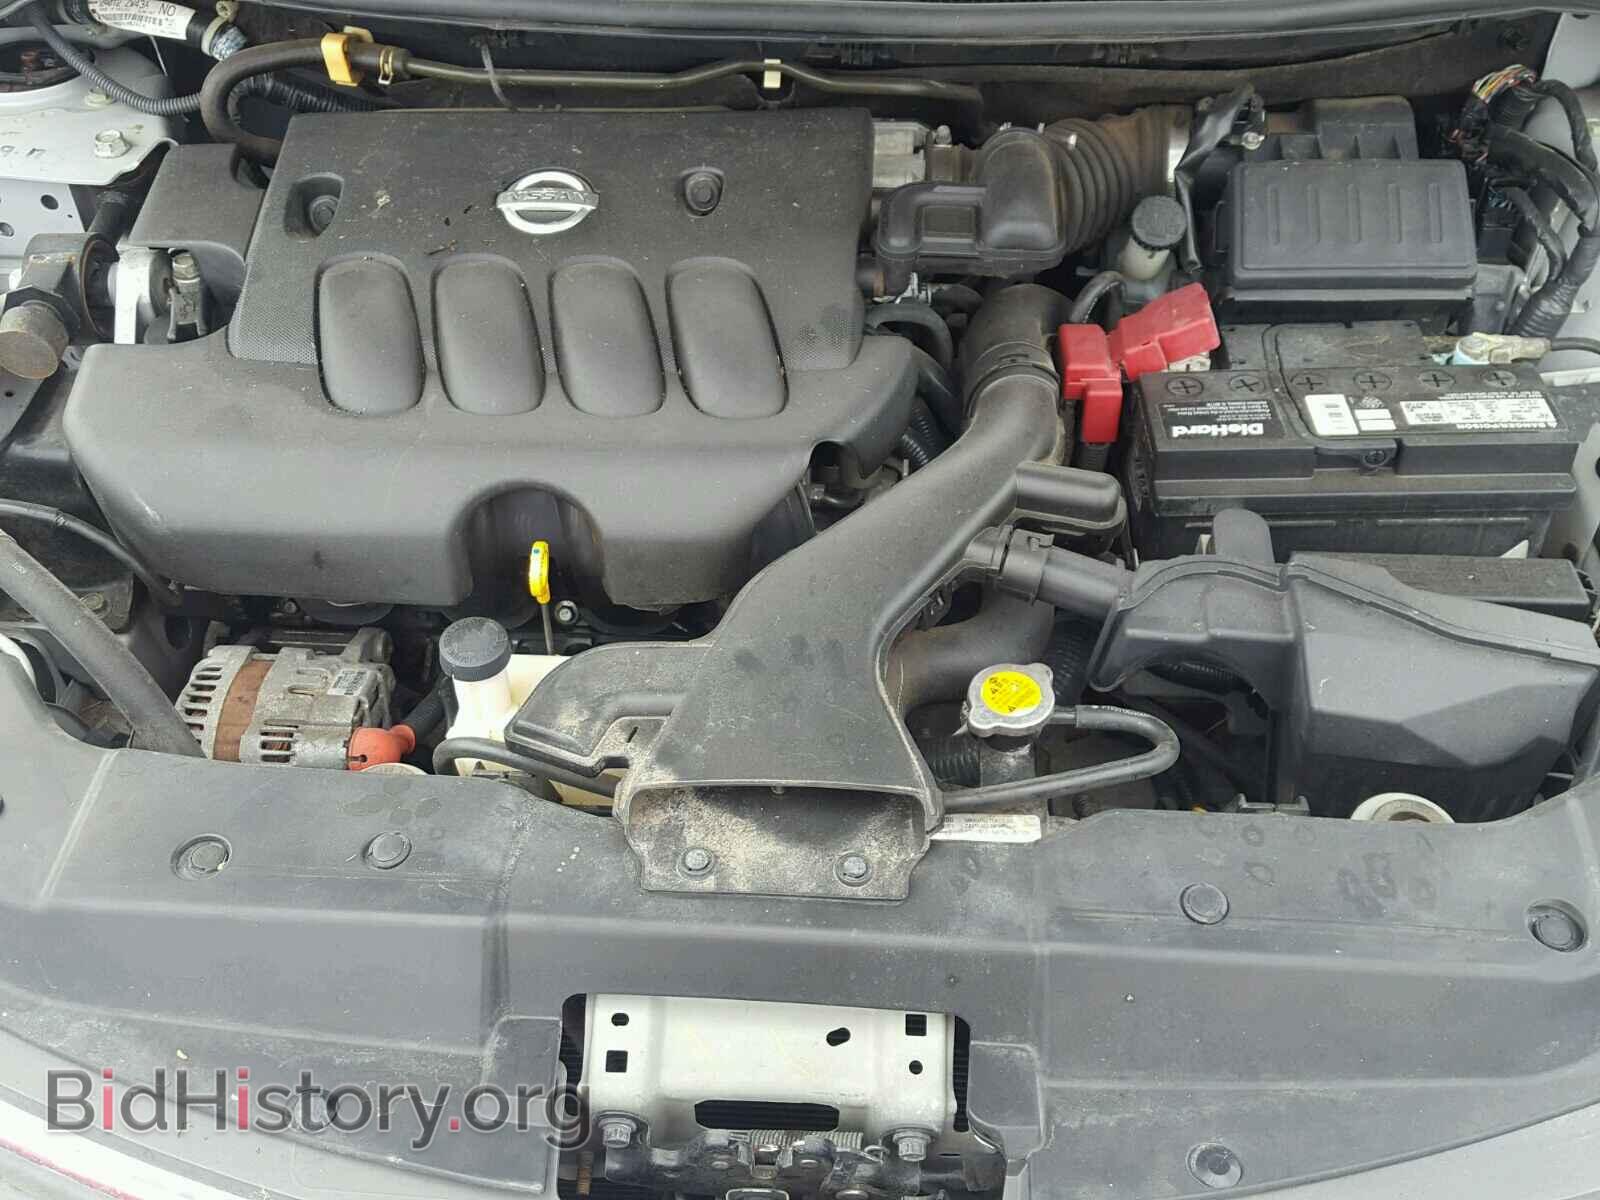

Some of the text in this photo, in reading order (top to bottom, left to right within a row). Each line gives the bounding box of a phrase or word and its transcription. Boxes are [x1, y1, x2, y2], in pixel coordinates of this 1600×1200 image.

[158, 3, 177, 16] NO
[506, 190, 589, 202] NISSAN
[1172, 423, 1264, 438] DieHard
